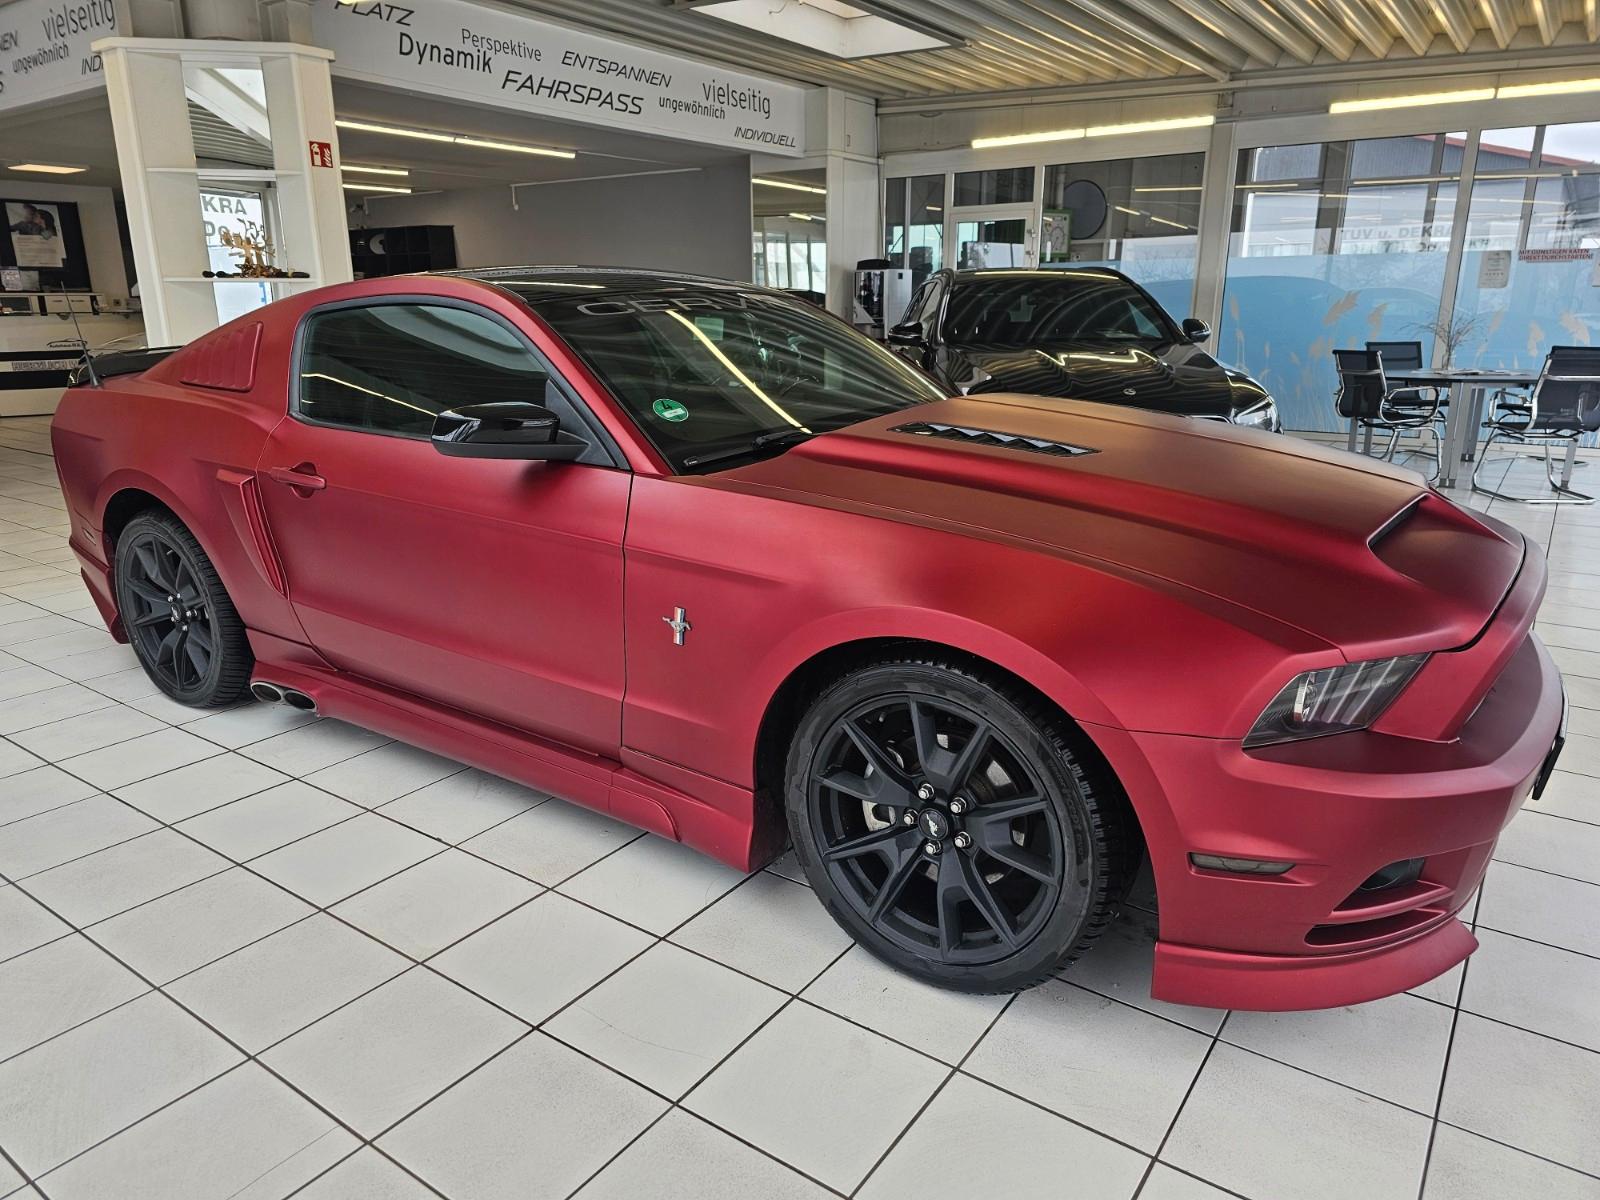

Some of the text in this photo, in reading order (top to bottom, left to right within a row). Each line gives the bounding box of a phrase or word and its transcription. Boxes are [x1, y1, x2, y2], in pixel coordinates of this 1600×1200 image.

[41, 0, 116, 41] vielseitig
[12, 41, 70, 74] ungewöhnlich
[399, 31, 493, 74] Dynamik
[461, 28, 542, 62] Perspektive
[561, 50, 673, 88] ENTSPANNEN
[501, 69, 645, 115] FAHRSPASS
[658, 96, 726, 120] ungewöhnlich
[702, 79, 771, 120] vielseitig
[734, 126, 797, 148] INDIVIDUELL
